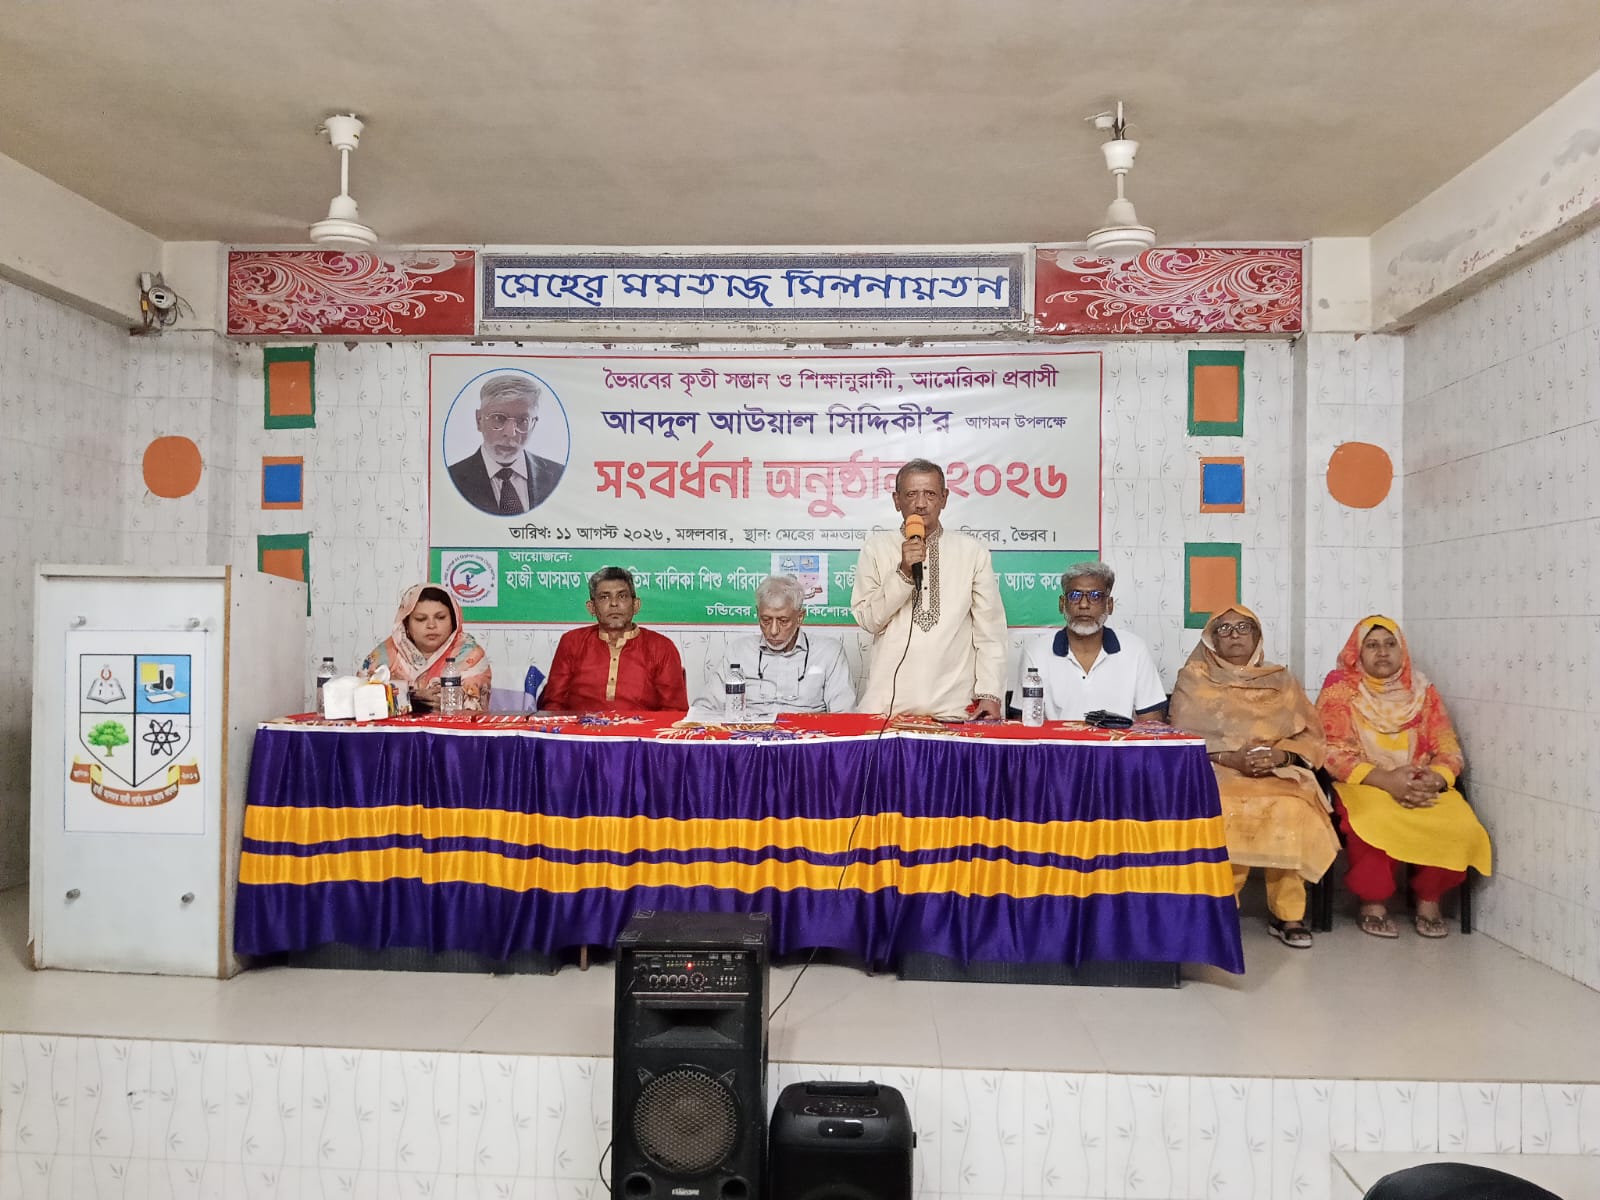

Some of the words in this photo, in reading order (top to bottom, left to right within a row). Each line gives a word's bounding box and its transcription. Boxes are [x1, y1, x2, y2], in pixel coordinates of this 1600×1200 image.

[497, 273, 608, 306] মেহের
[617, 273, 774, 307] মমতাজ
[780, 269, 1009, 301] মিলনায়তন
[602, 367, 673, 389] ভৈরবের
[678, 368, 719, 397] কৃতী
[723, 371, 771, 390] সন্তান
[777, 373, 793, 389] ও
[798, 368, 904, 393] শিক্ষানুরাগী,
[910, 366, 998, 389] আমেরিকা
[1002, 363, 1060, 389] প্রবাসী
[600, 408, 701, 441] আবদুল
[707, 404, 818, 435] আউয়াল
[965, 415, 1010, 431] আগমন
[1014, 413, 1068, 431] উপলক্ষে
[594, 440, 753, 500] সংবর্ধনা
[946, 461, 1068, 499] ২০২৬
[508, 523, 551, 540] তারিখ:
[556, 527, 572, 540] ১১
[576, 523, 619, 540] আগস্ট
[743, 527, 771, 544] স্থান:
[775, 528, 816, 541] মেহের
[818, 527, 868, 541] মমতাজ
[505, 564, 534, 589] হাজী
[536, 570, 582, 590] আসমত
[654, 566, 696, 590] বালিকা
[698, 565, 723, 591] শিশু
